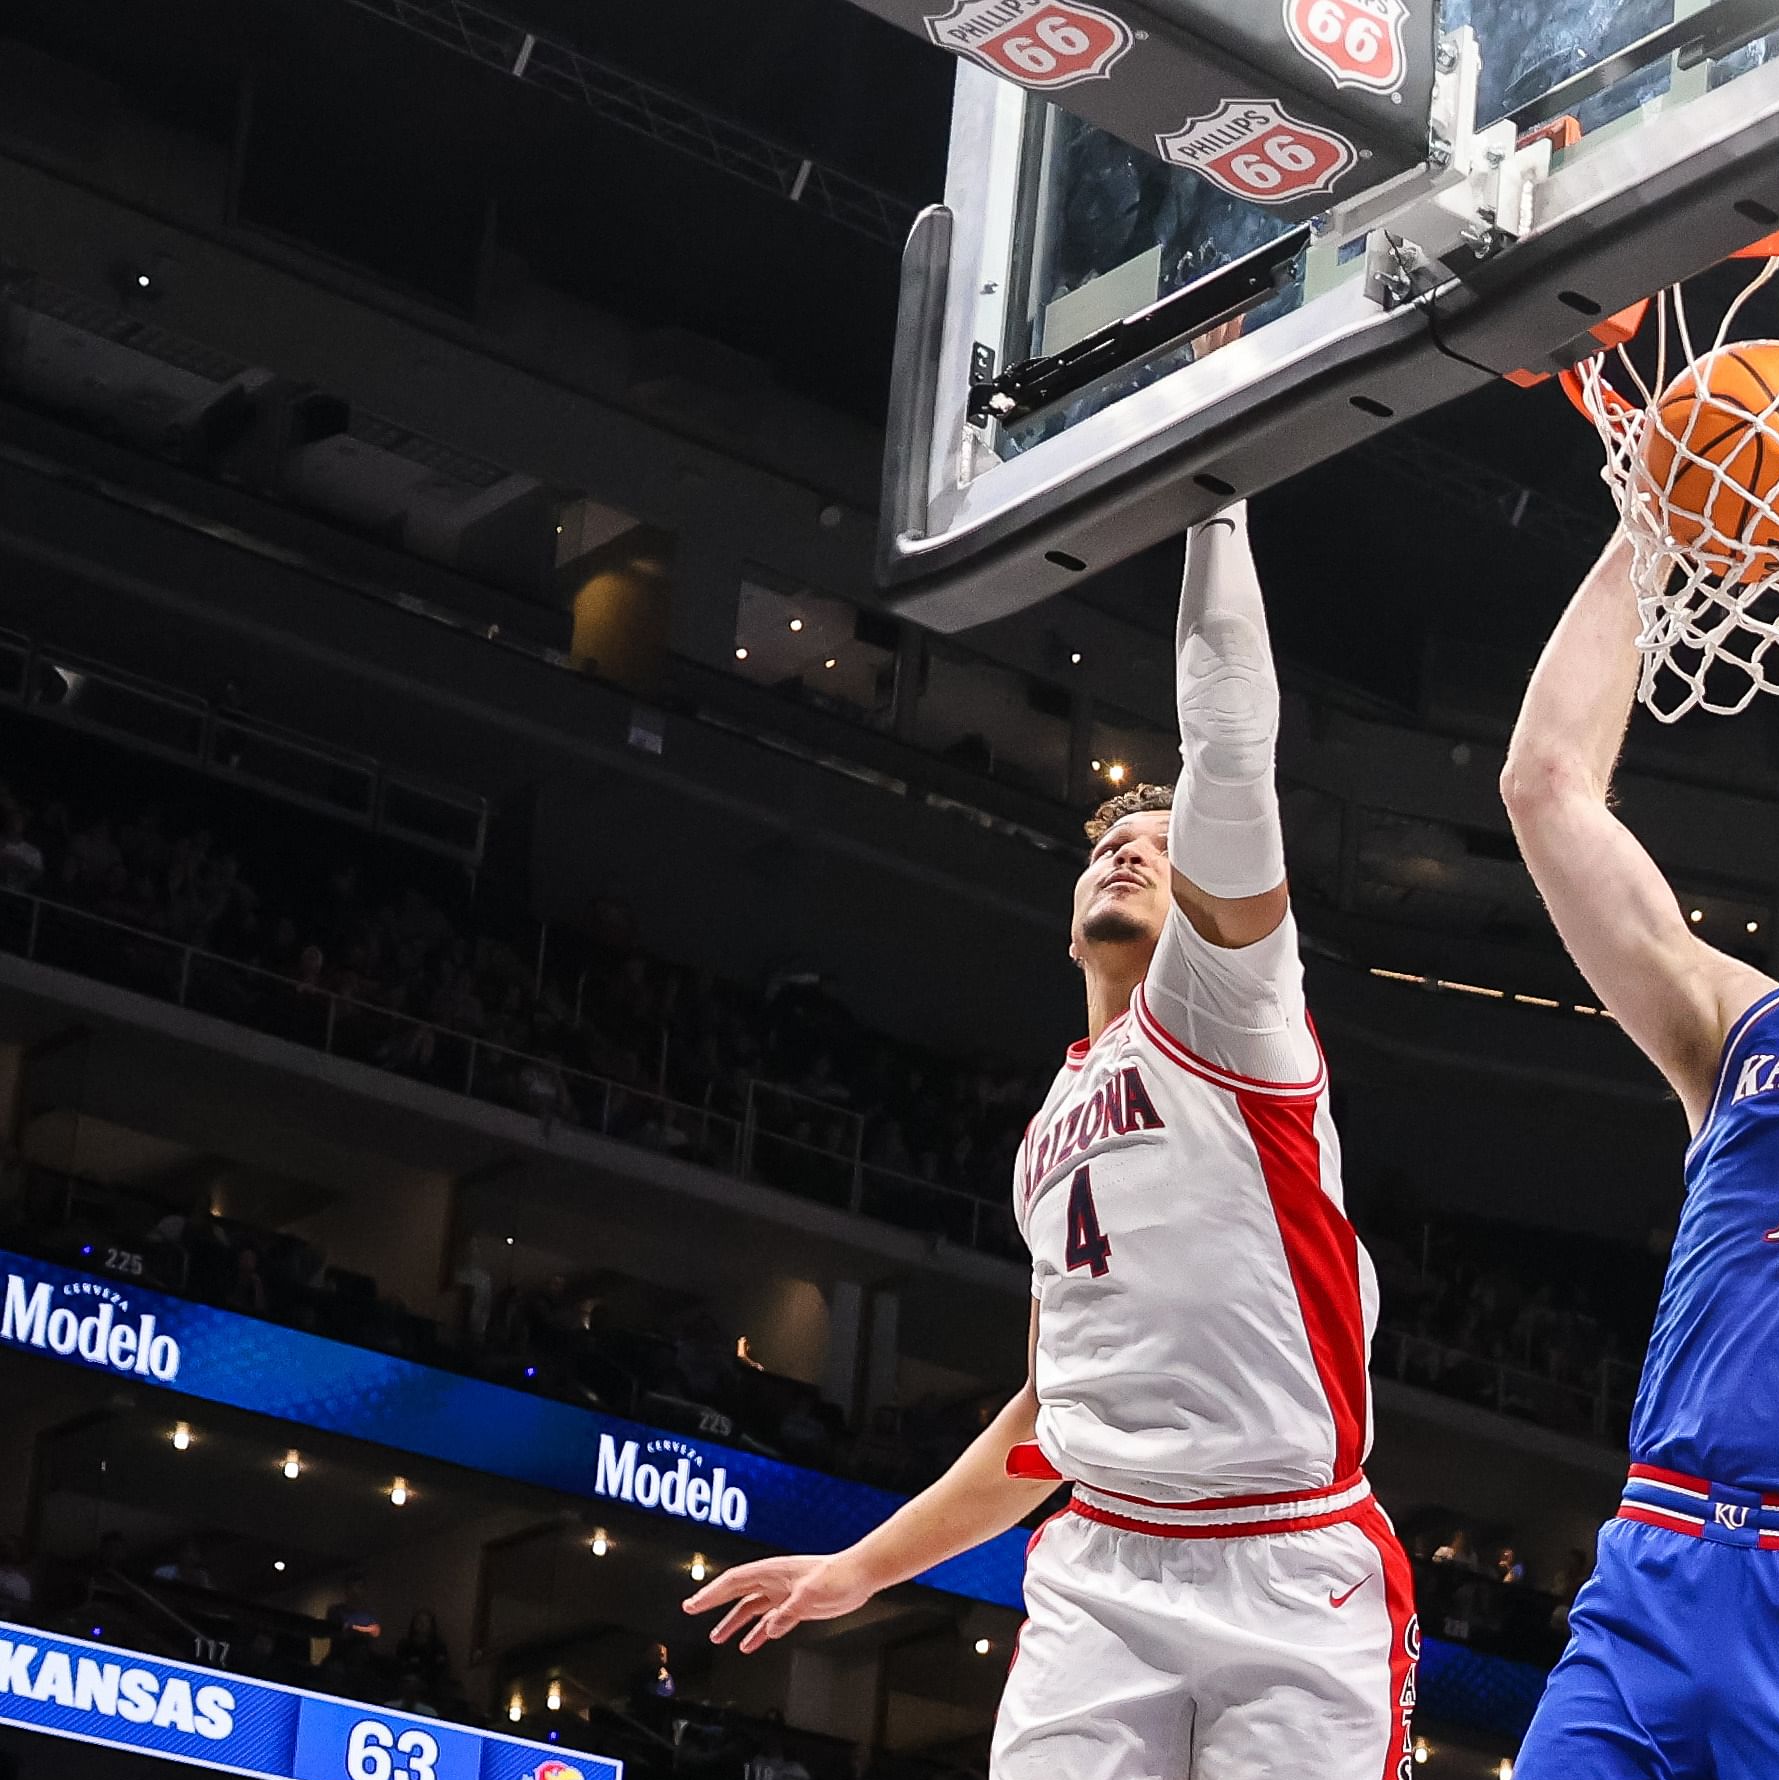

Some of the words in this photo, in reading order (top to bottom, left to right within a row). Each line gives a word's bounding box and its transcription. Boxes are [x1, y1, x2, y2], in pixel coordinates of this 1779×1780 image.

[1002, 16, 1090, 74] 66
[1308, 0, 1382, 63] 66
[1179, 109, 1270, 159] PHILLIPS
[1231, 135, 1315, 189] 66
[1066, 1163, 1112, 1278] 4
[0, 1274, 180, 1382] Modelo
[594, 1433, 747, 1531] Modelo
[1714, 1502, 1749, 1530] KU
[0, 1640, 235, 1741] KANSAS
